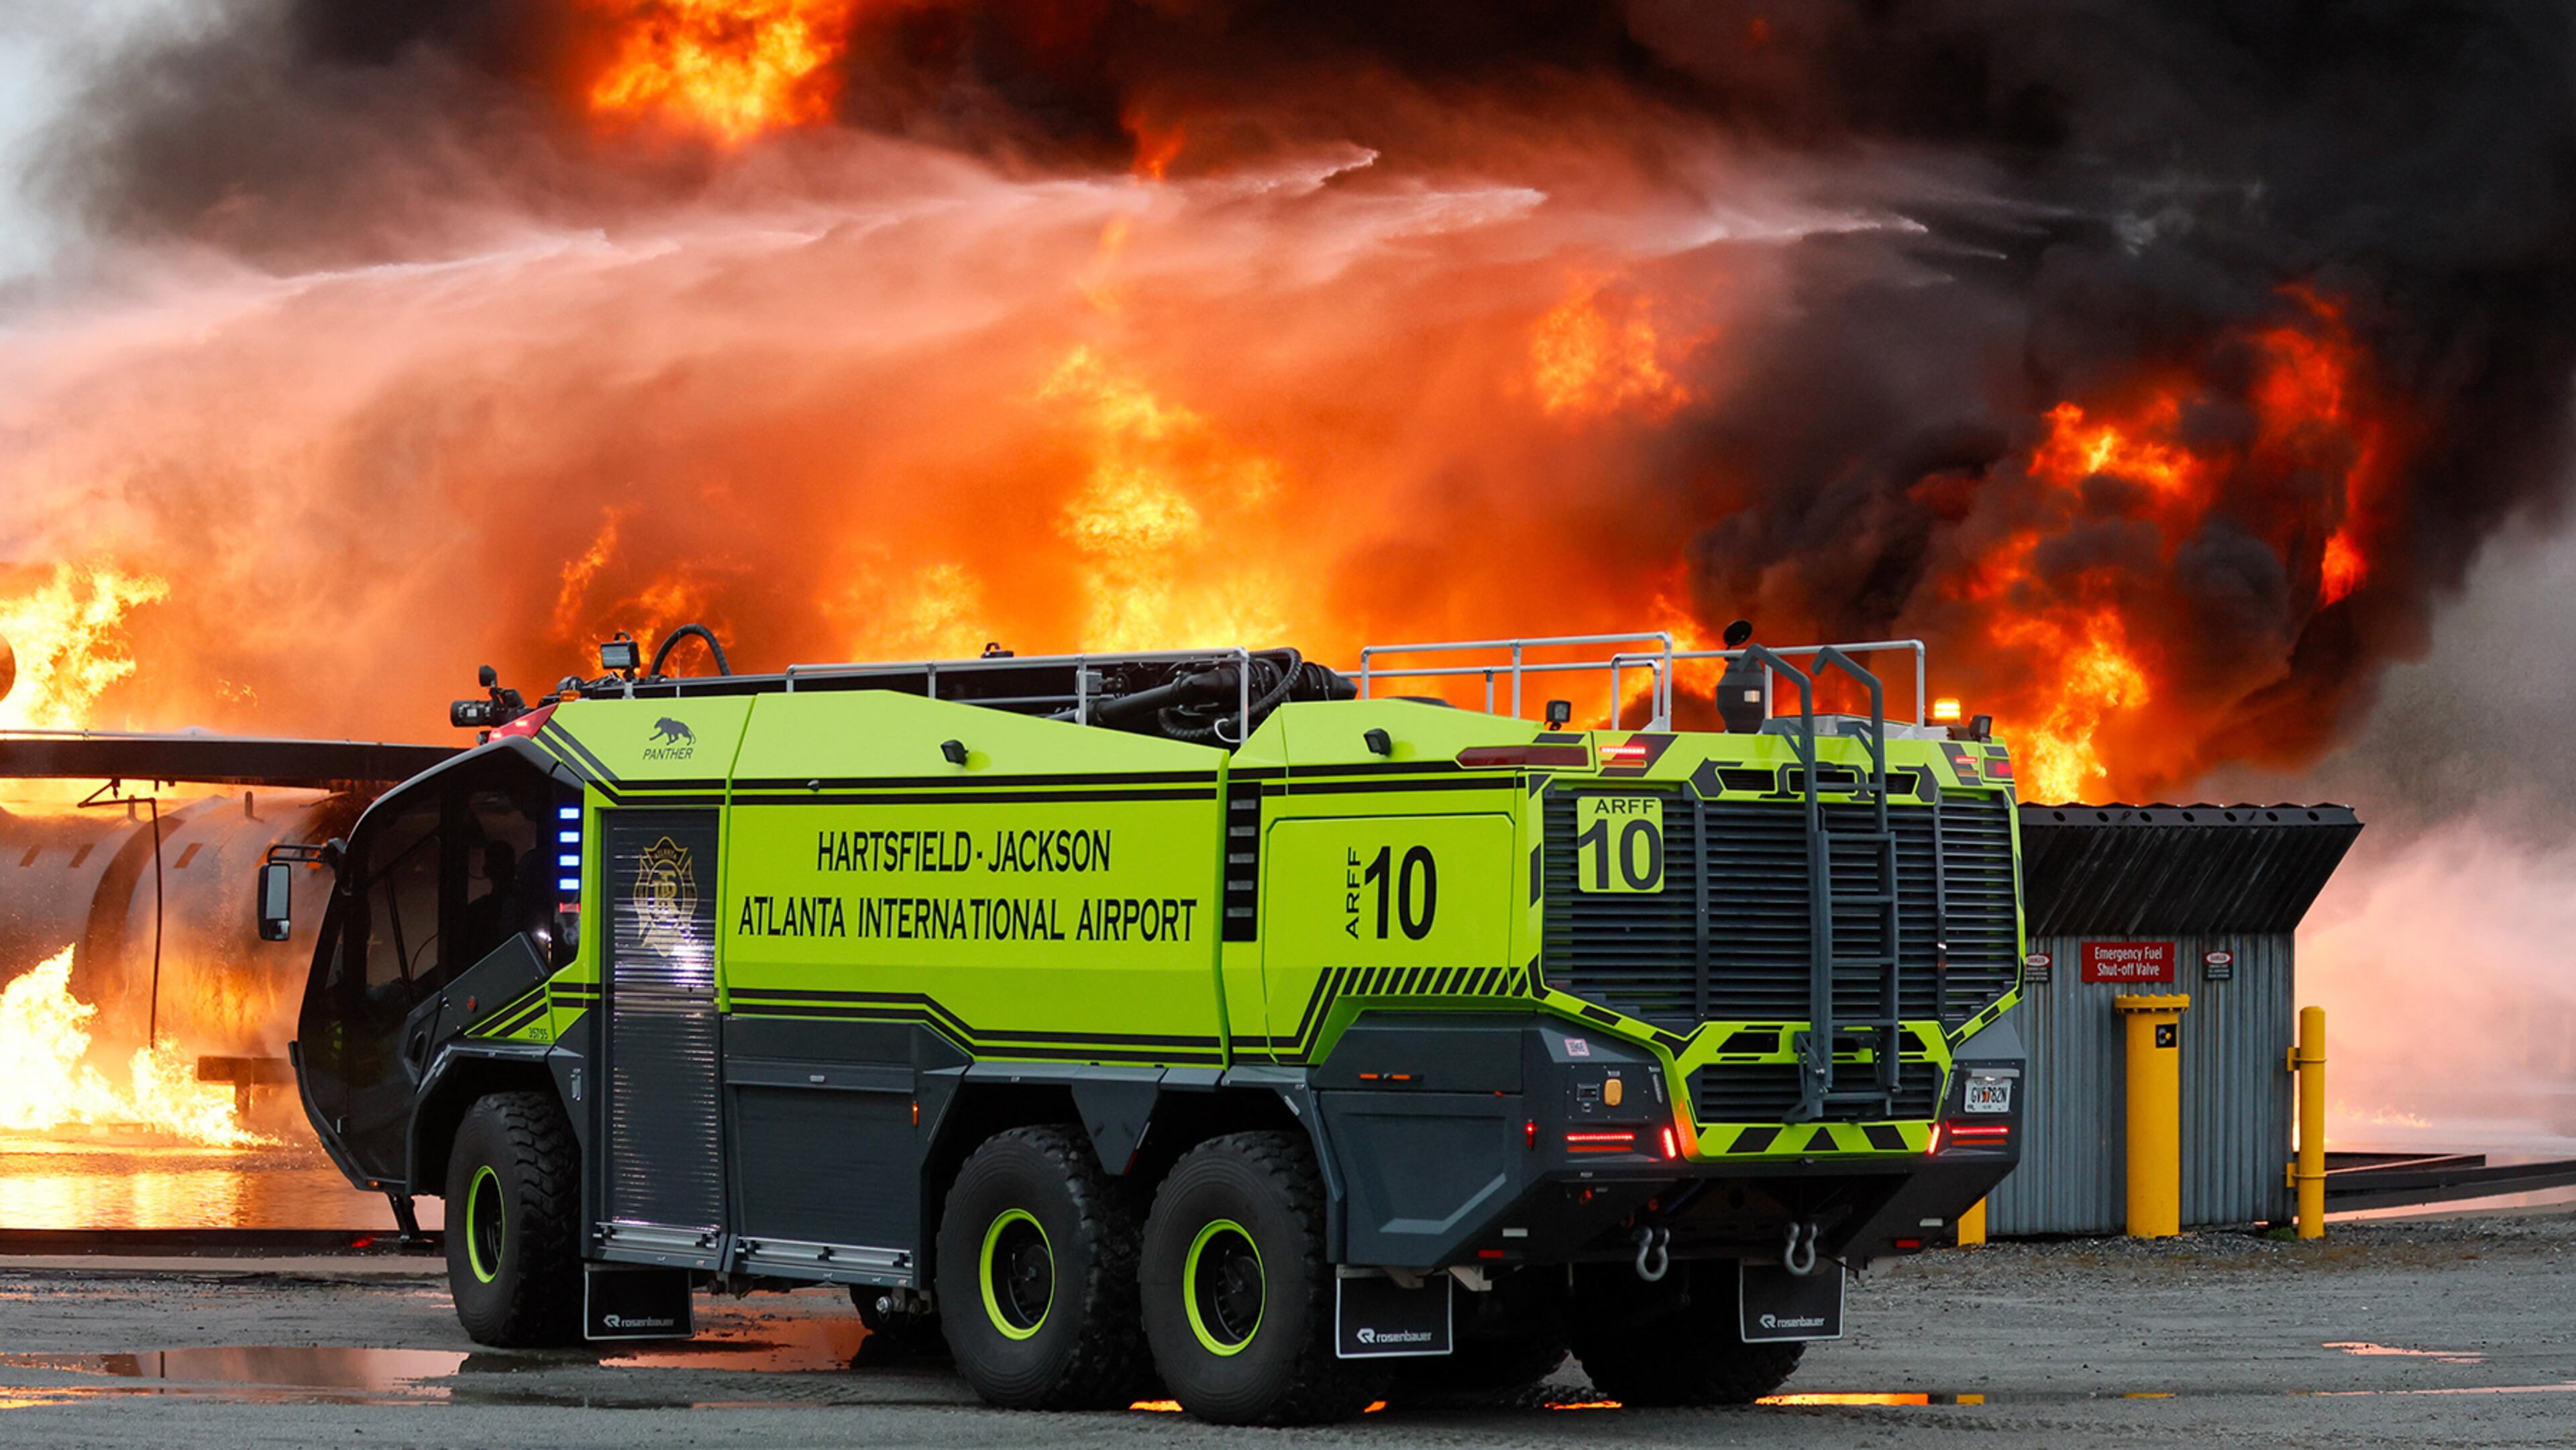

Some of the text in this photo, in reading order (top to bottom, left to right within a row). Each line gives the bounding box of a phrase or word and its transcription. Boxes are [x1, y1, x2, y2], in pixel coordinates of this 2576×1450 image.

[643, 747, 694, 760] PANTHER
[1595, 798, 1656, 814] ARFF
[817, 831, 971, 872] HARTSFIELD
[987, 829, 1112, 872] JACKSON
[1578, 819, 1662, 890] 10
[1345, 846, 1361, 939] ARFF
[1364, 845, 1437, 941] 10
[738, 896, 1197, 941] ATLANTA INTERNATIONAL AIRPORT
[2094, 946, 2163, 962] Emergency Fuel
[2097, 962, 2160, 976] Shut-off Valve
[621, 1316, 674, 1328] rosenbauer
[1778, 1315, 1825, 1328] rosenbauer
[1376, 1329, 1432, 1343] rosenbauer
